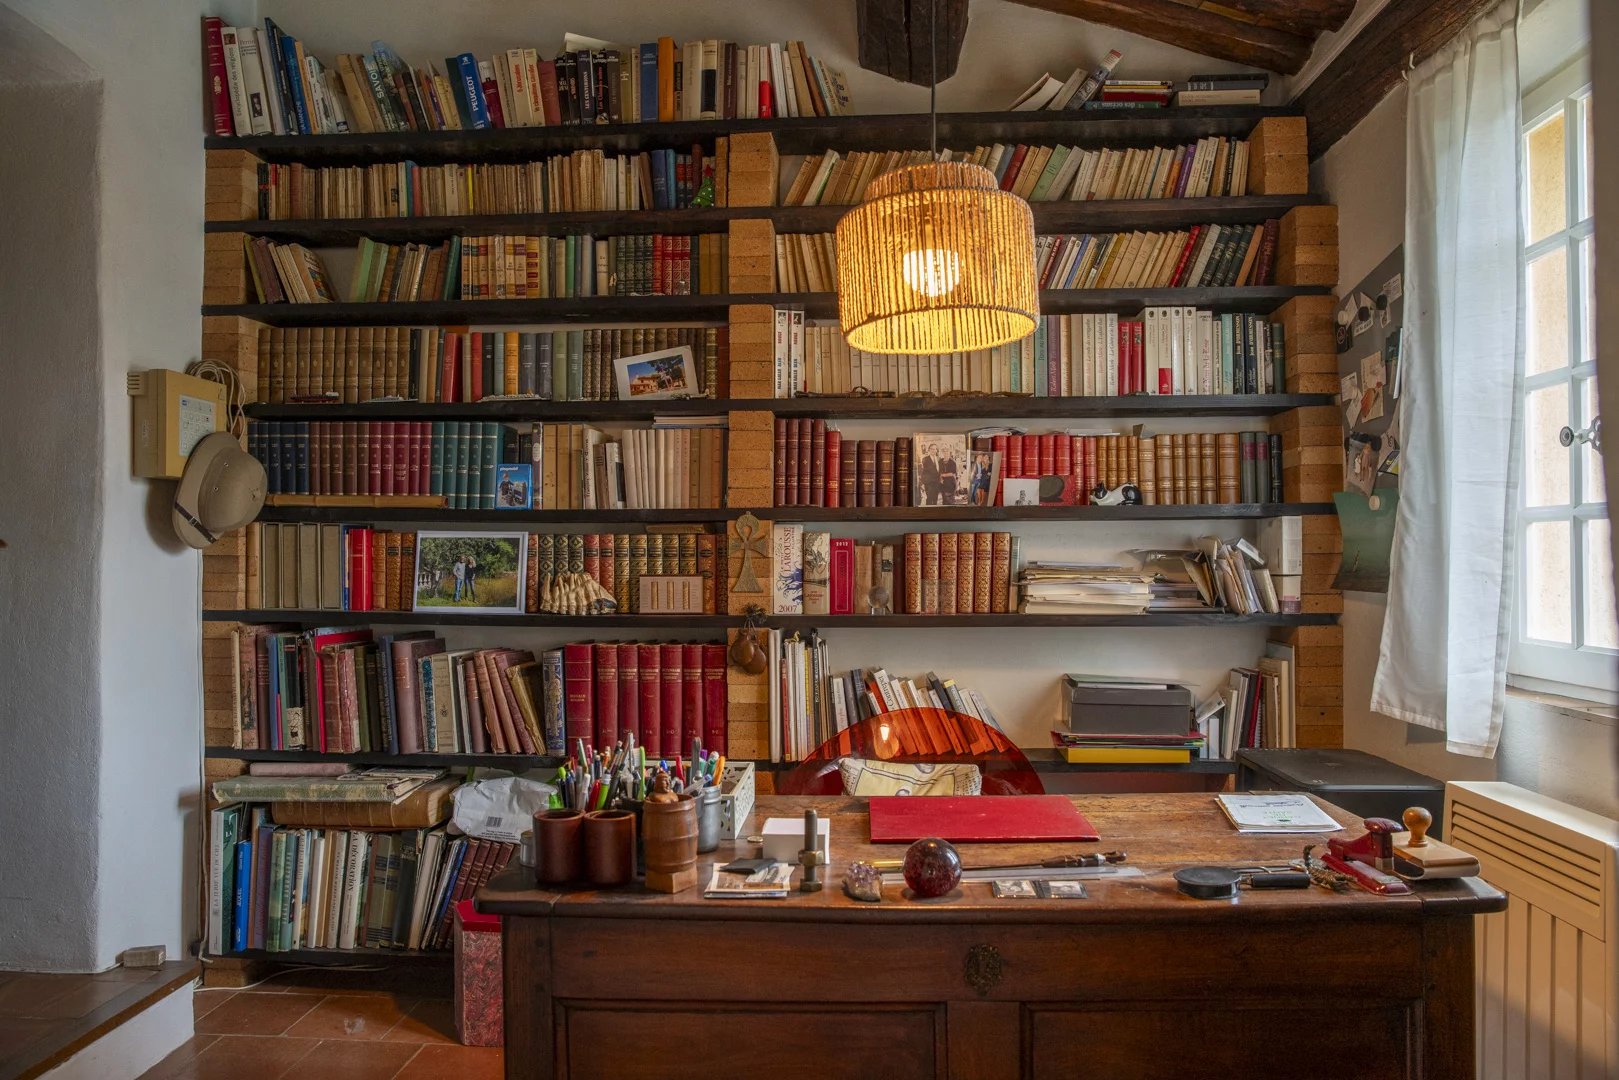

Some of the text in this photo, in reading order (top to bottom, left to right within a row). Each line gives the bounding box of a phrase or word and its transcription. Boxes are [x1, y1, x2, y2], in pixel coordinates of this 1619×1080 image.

[370, 63, 384, 98] SAVOIE
[466, 76, 478, 112] PEUGEOT
[347, 845, 358, 892] DÉCORATION
[213, 898, 219, 906] LA
